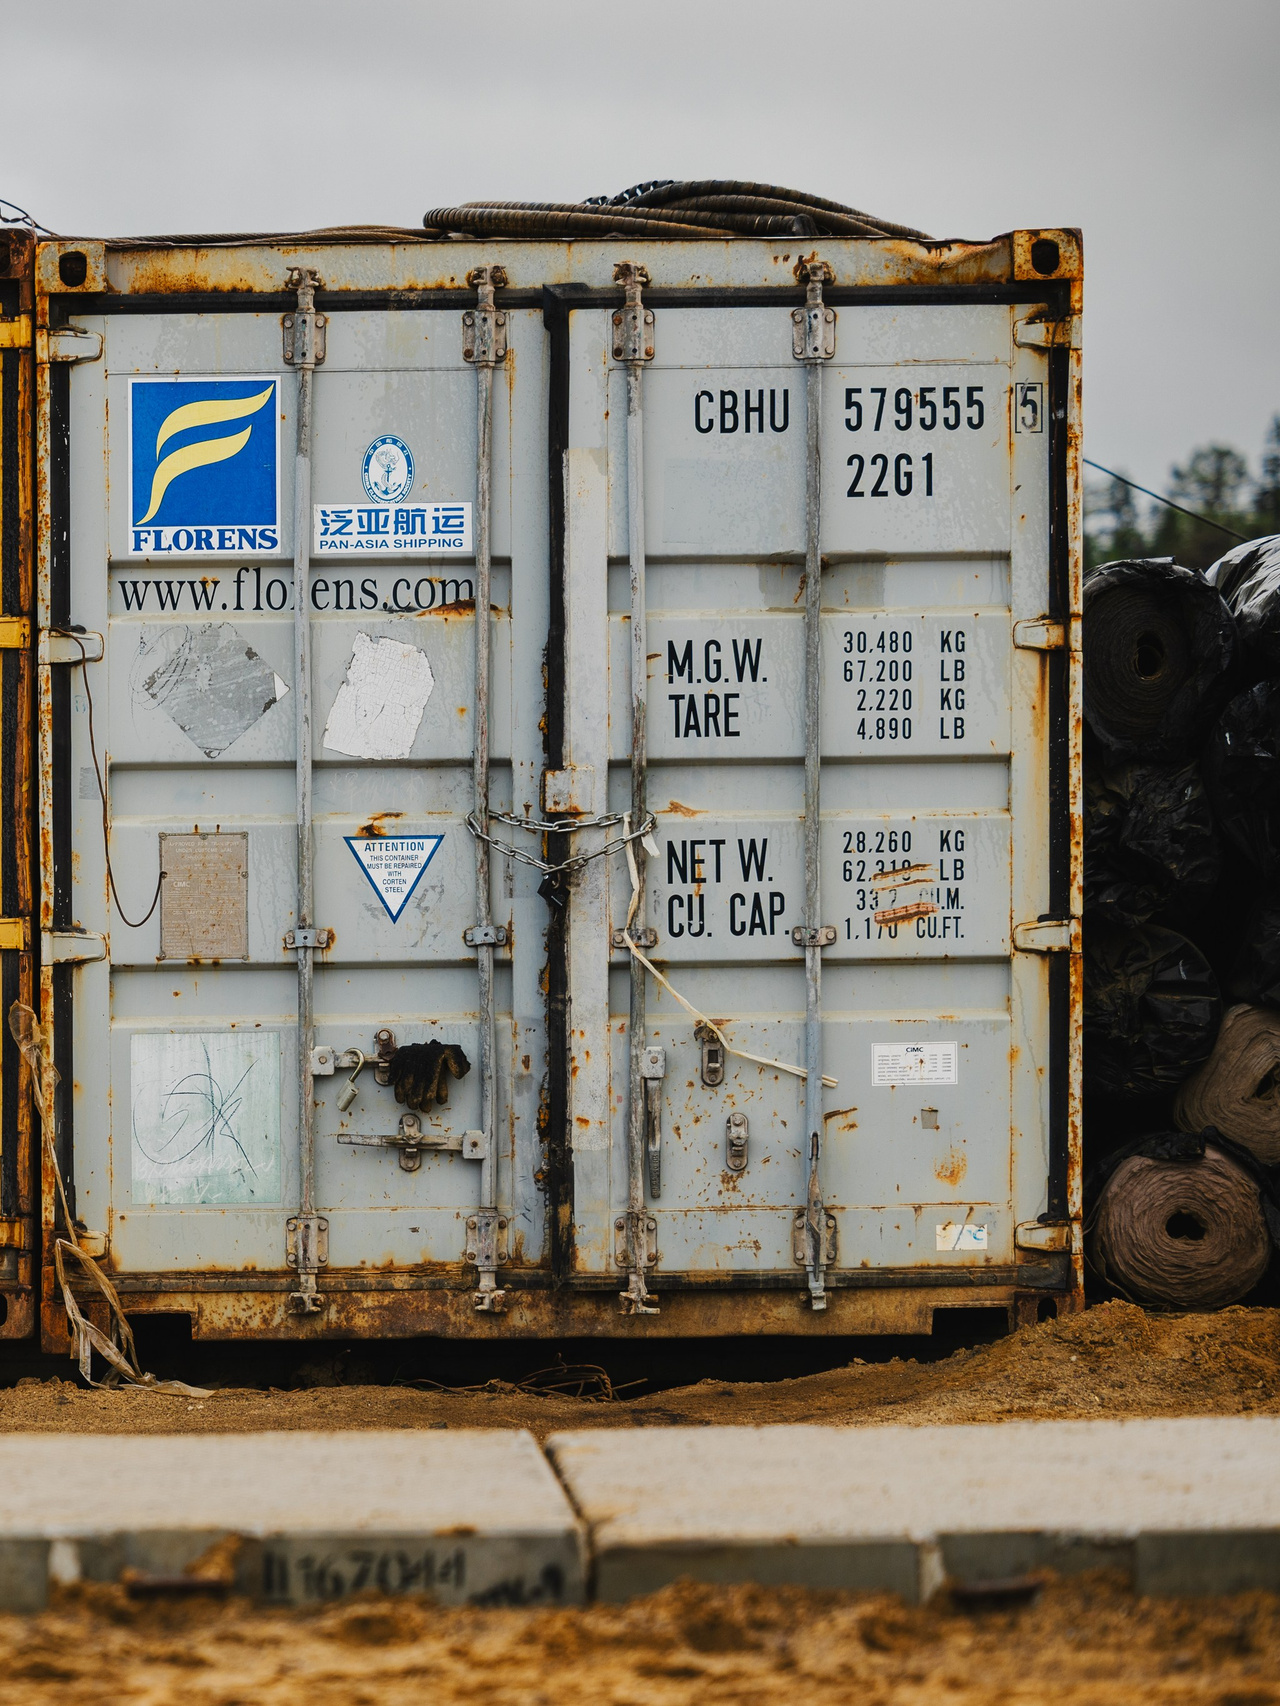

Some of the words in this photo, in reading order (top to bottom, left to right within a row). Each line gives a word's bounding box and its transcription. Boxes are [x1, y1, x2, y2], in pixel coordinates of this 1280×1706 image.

[694, 388, 789, 434] CBHU
[845, 386, 984, 432] 579555
[1021, 386, 1037, 429] 5
[847, 452, 933, 497] 22G1
[320, 507, 464, 536] 泛亚航运
[132, 528, 278, 552] FLORENS
[320, 539, 389, 549] PAN-ASIA
[394, 538, 463, 549] SHIPPING
[843, 630, 912, 653] 30,480
[940, 630, 965, 652] KG
[667, 638, 768, 684] M.G.W.
[843, 660, 912, 682] 67,200
[940, 659, 965, 681] LB
[857, 688, 911, 711] 2,220
[940, 688, 965, 710] KG
[668, 693, 740, 738] TARE
[857, 717, 911, 740] 4,890
[940, 717, 965, 739] LB
[365, 842, 424, 852] ATTENTION
[843, 830, 911, 853] 28,260
[940, 830, 965, 852] KG
[667, 839, 726, 884] NET
[738, 838, 773, 882] W.
[940, 859, 965, 881] LB
[668, 893, 712, 937] CU.
[729, 892, 789, 936] CAP.
[917, 916, 964, 938] CU.FT.
